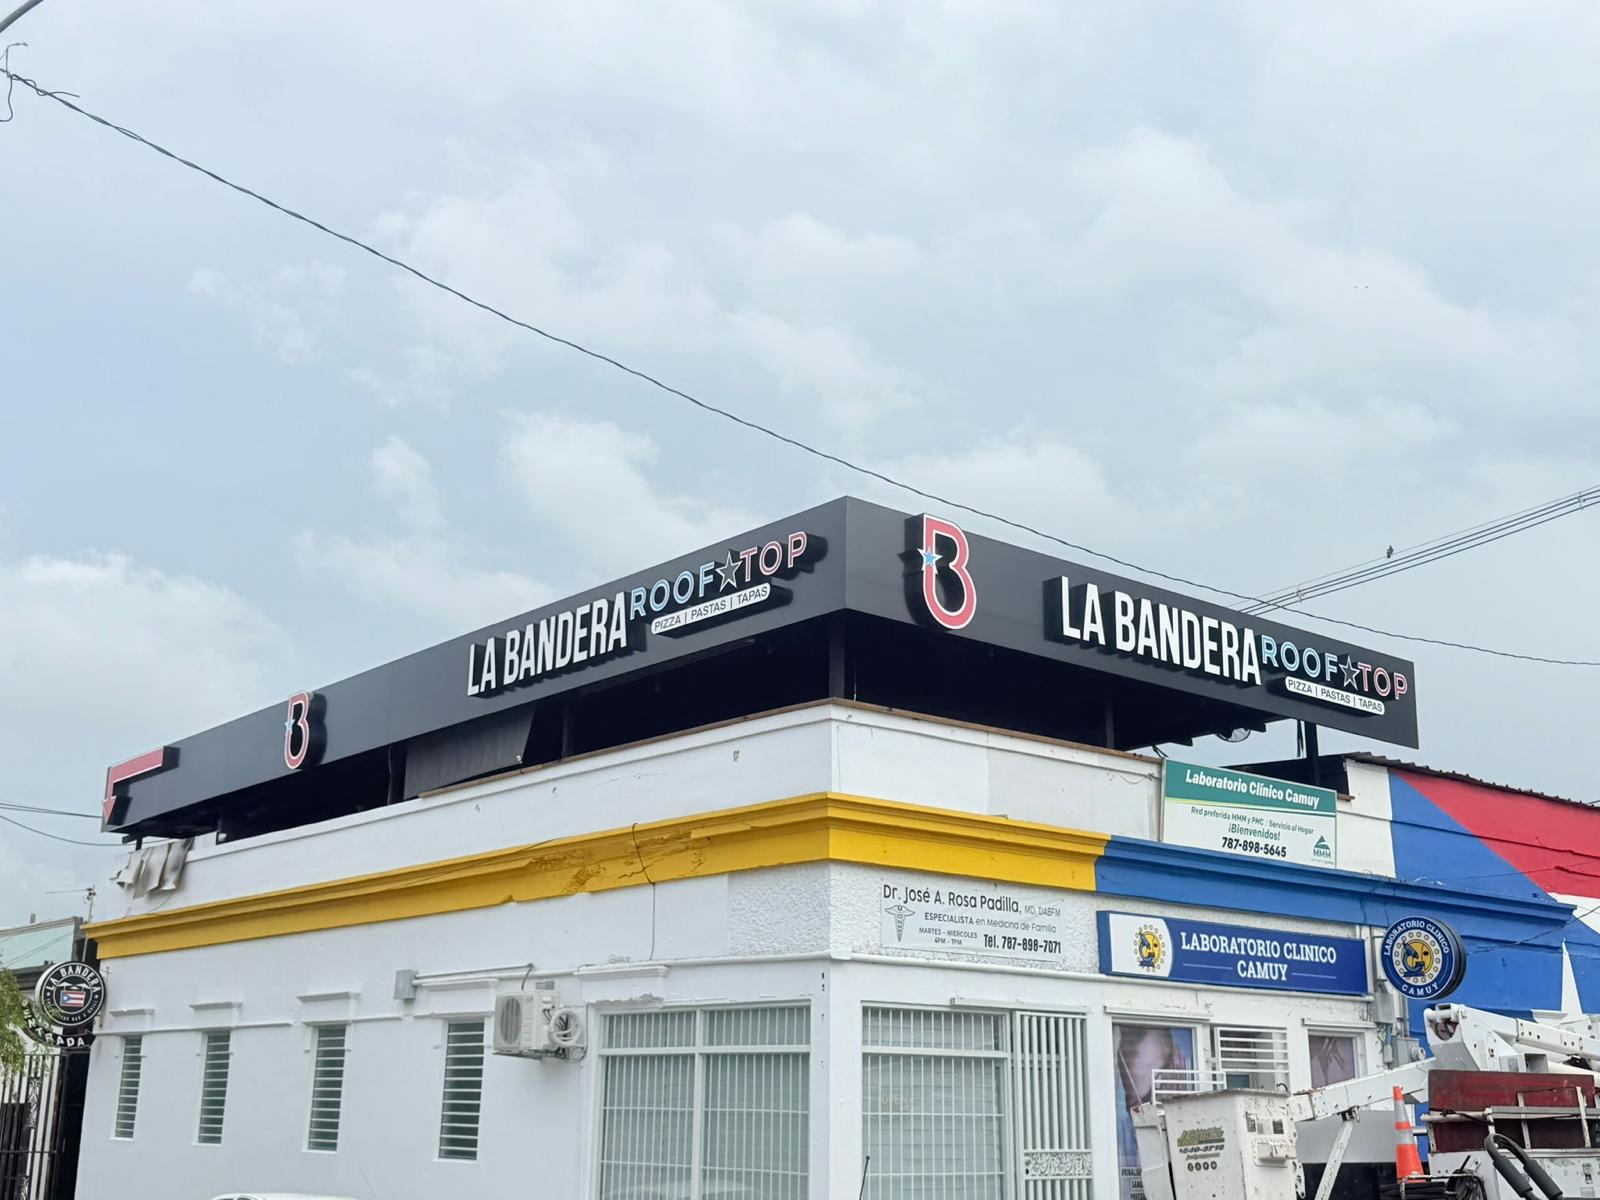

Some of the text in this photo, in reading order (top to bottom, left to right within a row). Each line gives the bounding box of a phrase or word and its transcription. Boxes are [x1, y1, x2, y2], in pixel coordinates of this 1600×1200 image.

[654, 615, 682, 631] PIZZA
[691, 601, 727, 620] PASTAS
[737, 586, 768, 605] TAPAS
[467, 592, 628, 697] LA BANDERA
[1060, 575, 1262, 686] LA BANDERA
[1288, 679, 1313, 694] PIZZA
[1321, 688, 1351, 704] PASTAS
[1358, 698, 1383, 713] TAPAS
[1186, 769, 1320, 810] Laboratorio Clínico Camuy
[1191, 806, 1203, 815] Red
[1203, 809, 1230, 821] preferida
[1231, 814, 1247, 822] MMM
[1251, 817, 1264, 825] PMC
[1269, 820, 1291, 830] Servicio
[1298, 825, 1314, 836] Hogar
[1228, 823, 1281, 841] ¡Bienvenidos!
[1222, 837, 1287, 857] 787-898-5645
[883, 884, 900, 900] Dr.
[903, 886, 931, 904] José
[934, 891, 945, 905] A.
[948, 892, 977, 908] Rosa
[980, 895, 1022, 915] Padilla,
[919, 927, 941, 936] MARTES
[924, 912, 1056, 933] ESPECIALISTA en Medicina de Familia
[984, 934, 1061, 954] Tel. 787-898-7071
[1180, 931, 1337, 964] LABORATORIO CLINICO
[1384, 920, 1450, 956] LABORATORIO CLINICO
[46, 965, 101, 993] LA BANDERA
[1237, 960, 1288, 981] CAMUY
[1401, 982, 1439, 996] CAMUY
